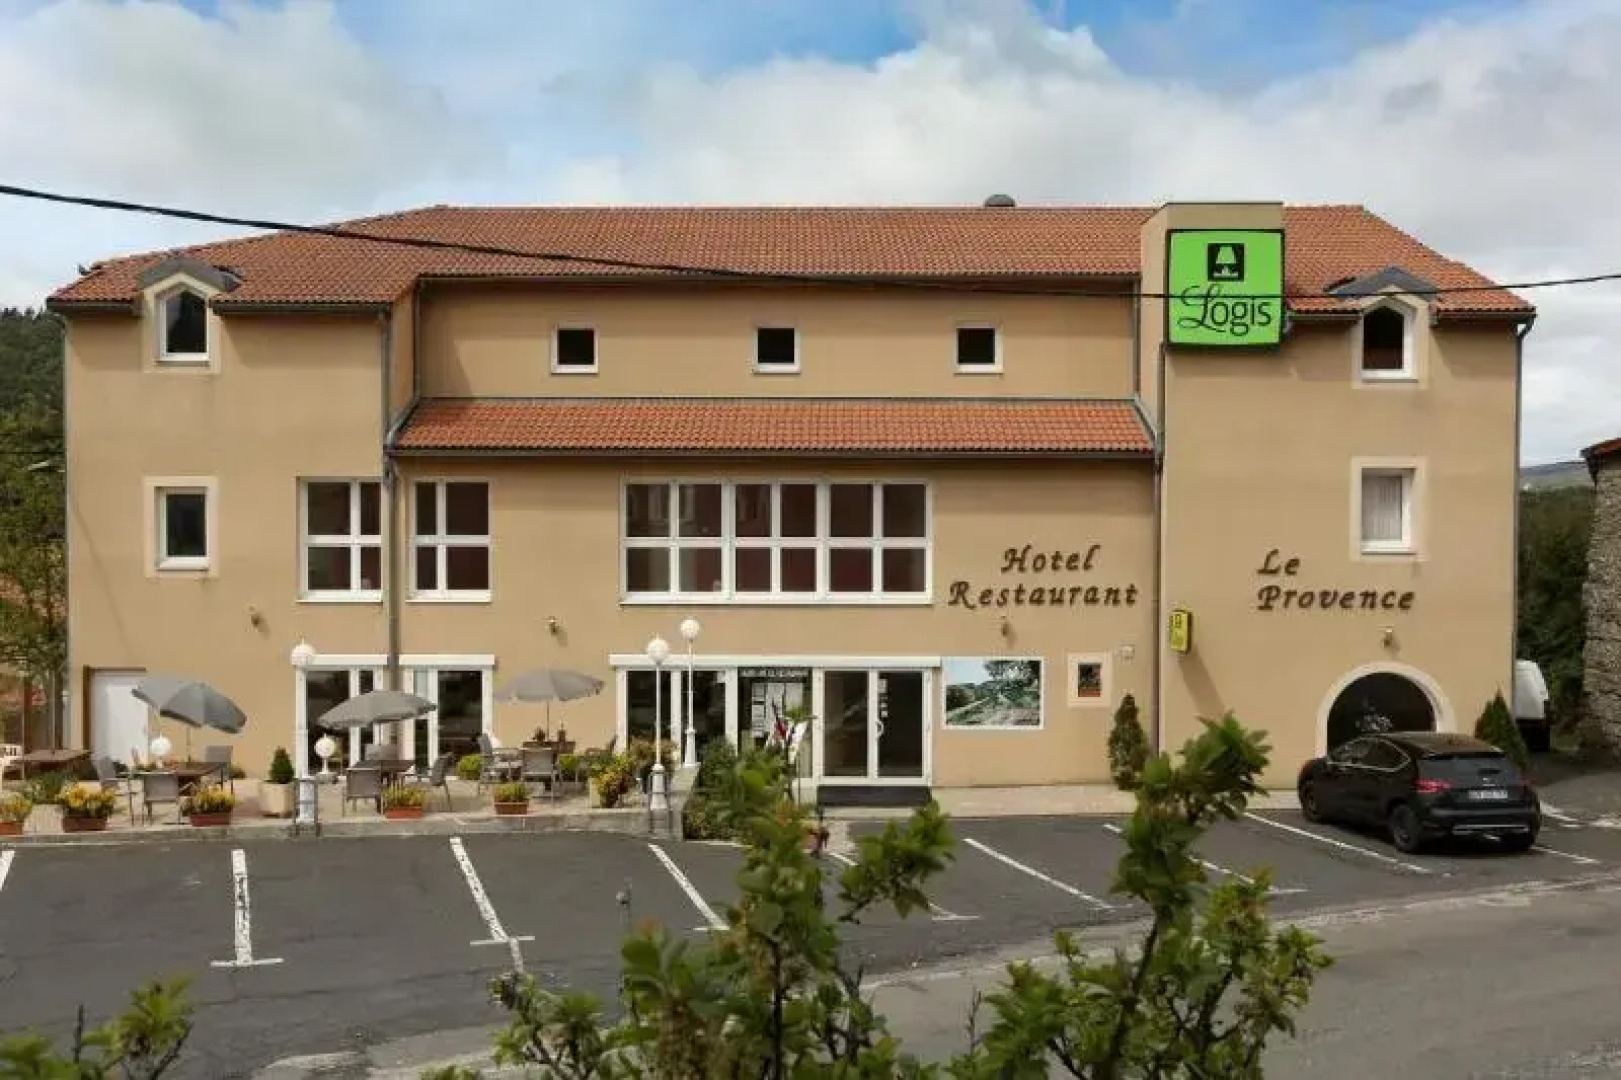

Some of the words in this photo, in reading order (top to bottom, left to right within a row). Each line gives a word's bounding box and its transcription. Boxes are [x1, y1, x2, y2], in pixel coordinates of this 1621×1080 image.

[1177, 284, 1272, 337] Logis
[1000, 544, 1101, 573] Hotel
[1256, 549, 1300, 576] Le
[948, 581, 1138, 610] Restaurant
[1257, 585, 1415, 610] Provence
